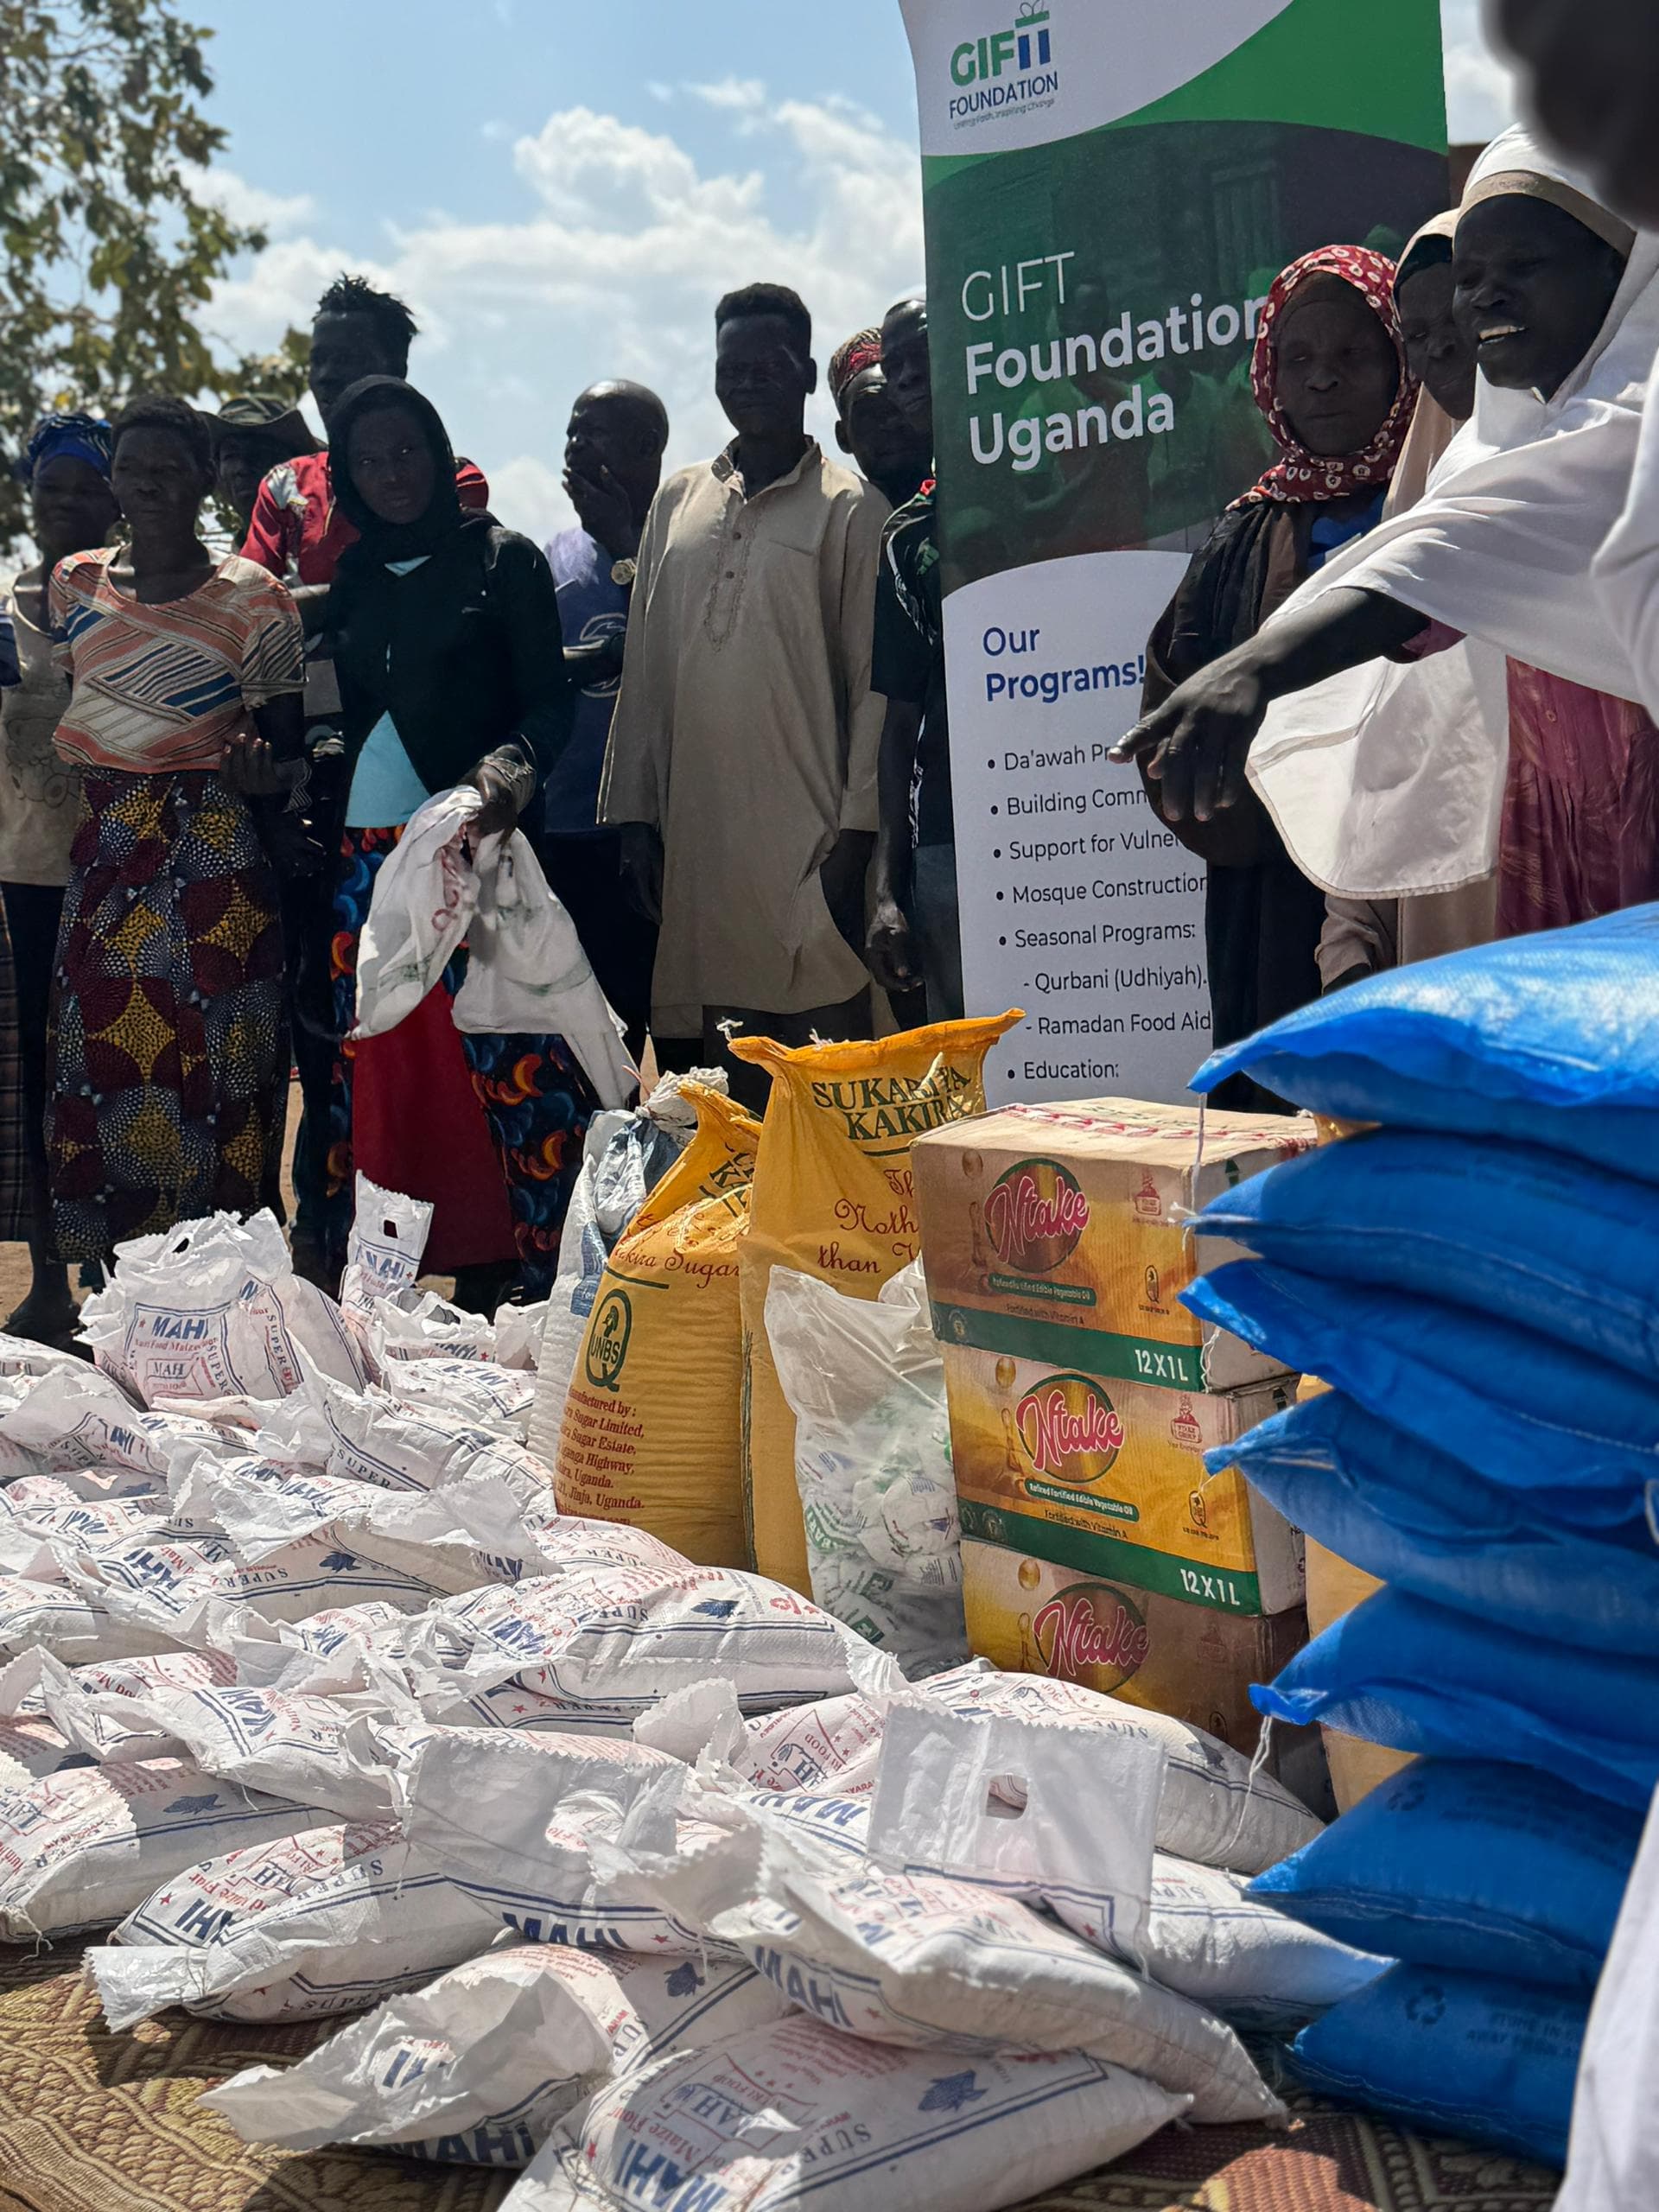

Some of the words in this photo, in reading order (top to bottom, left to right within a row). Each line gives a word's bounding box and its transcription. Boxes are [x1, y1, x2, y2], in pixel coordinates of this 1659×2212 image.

[950, 71, 1058, 119] FOUNDATION
[961, 251, 1076, 322] GIFT
[968, 383, 1175, 472] Uganda
[982, 627, 1040, 657] Our
[985, 654, 1146, 704] Programs!
[1004, 746, 1086, 771] Da'awah
[1007, 792, 1087, 816] Building
[1009, 836, 1087, 862] Support
[1090, 834, 1115, 854] for
[1012, 885, 1087, 906] Mosque
[1014, 925, 1096, 949] Seasonal
[1102, 923, 1197, 946] Programs:
[1034, 969, 1109, 995] Qurbani
[1038, 1014, 1125, 1035] Ramadan
[1130, 1012, 1176, 1033] Food
[1180, 1010, 1211, 1032] Aid
[1023, 1059, 1120, 1080] Education:
[983, 1174, 1091, 1264] Ntake
[817, 1241, 882, 1274] than
[266, 1313, 288, 1367] SUPER
[590, 1333, 621, 1365] UNBS
[573, 1408, 602, 1429] Sugar
[599, 1418, 645, 1438] Limited,
[616, 1401, 632, 1419] by
[570, 1427, 598, 1448] Sugar
[598, 1435, 637, 1456] Estate,
[1015, 1389, 1125, 1471] Ntake
[574, 1467, 614, 1489] Uganda.
[585, 1452, 635, 1476] Highway,
[595, 1492, 645, 1510] Uganda.
[1033, 1597, 1151, 1678] Ntake
[754, 1945, 855, 2029] MAHI
[613, 2138, 732, 2212] MAHI
